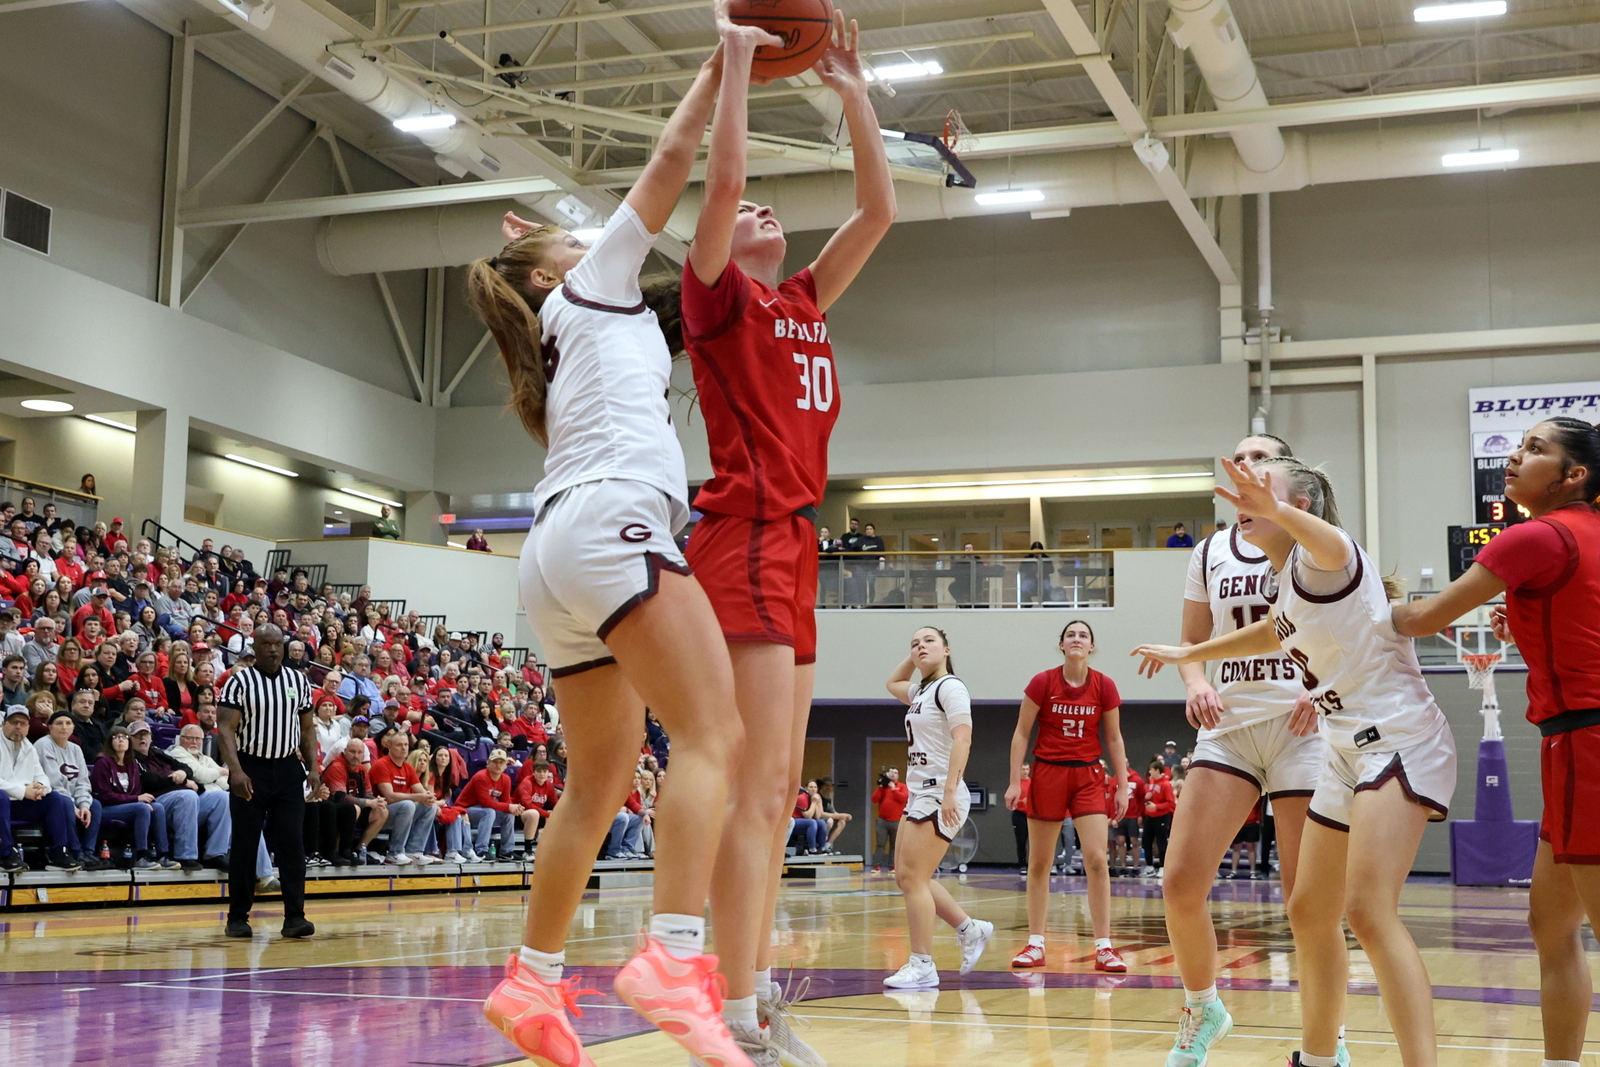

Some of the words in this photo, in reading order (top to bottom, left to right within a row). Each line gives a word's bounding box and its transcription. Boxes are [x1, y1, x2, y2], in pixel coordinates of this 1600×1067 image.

[792, 352, 833, 412] 30
[1482, 494, 1506, 503] FOULS
[1492, 502, 1504, 520] 3
[619, 523, 652, 543] G
[1221, 659, 1296, 684] COMETS
[1051, 703, 1097, 715] BELLEVUE
[1062, 719, 1085, 738] 21
